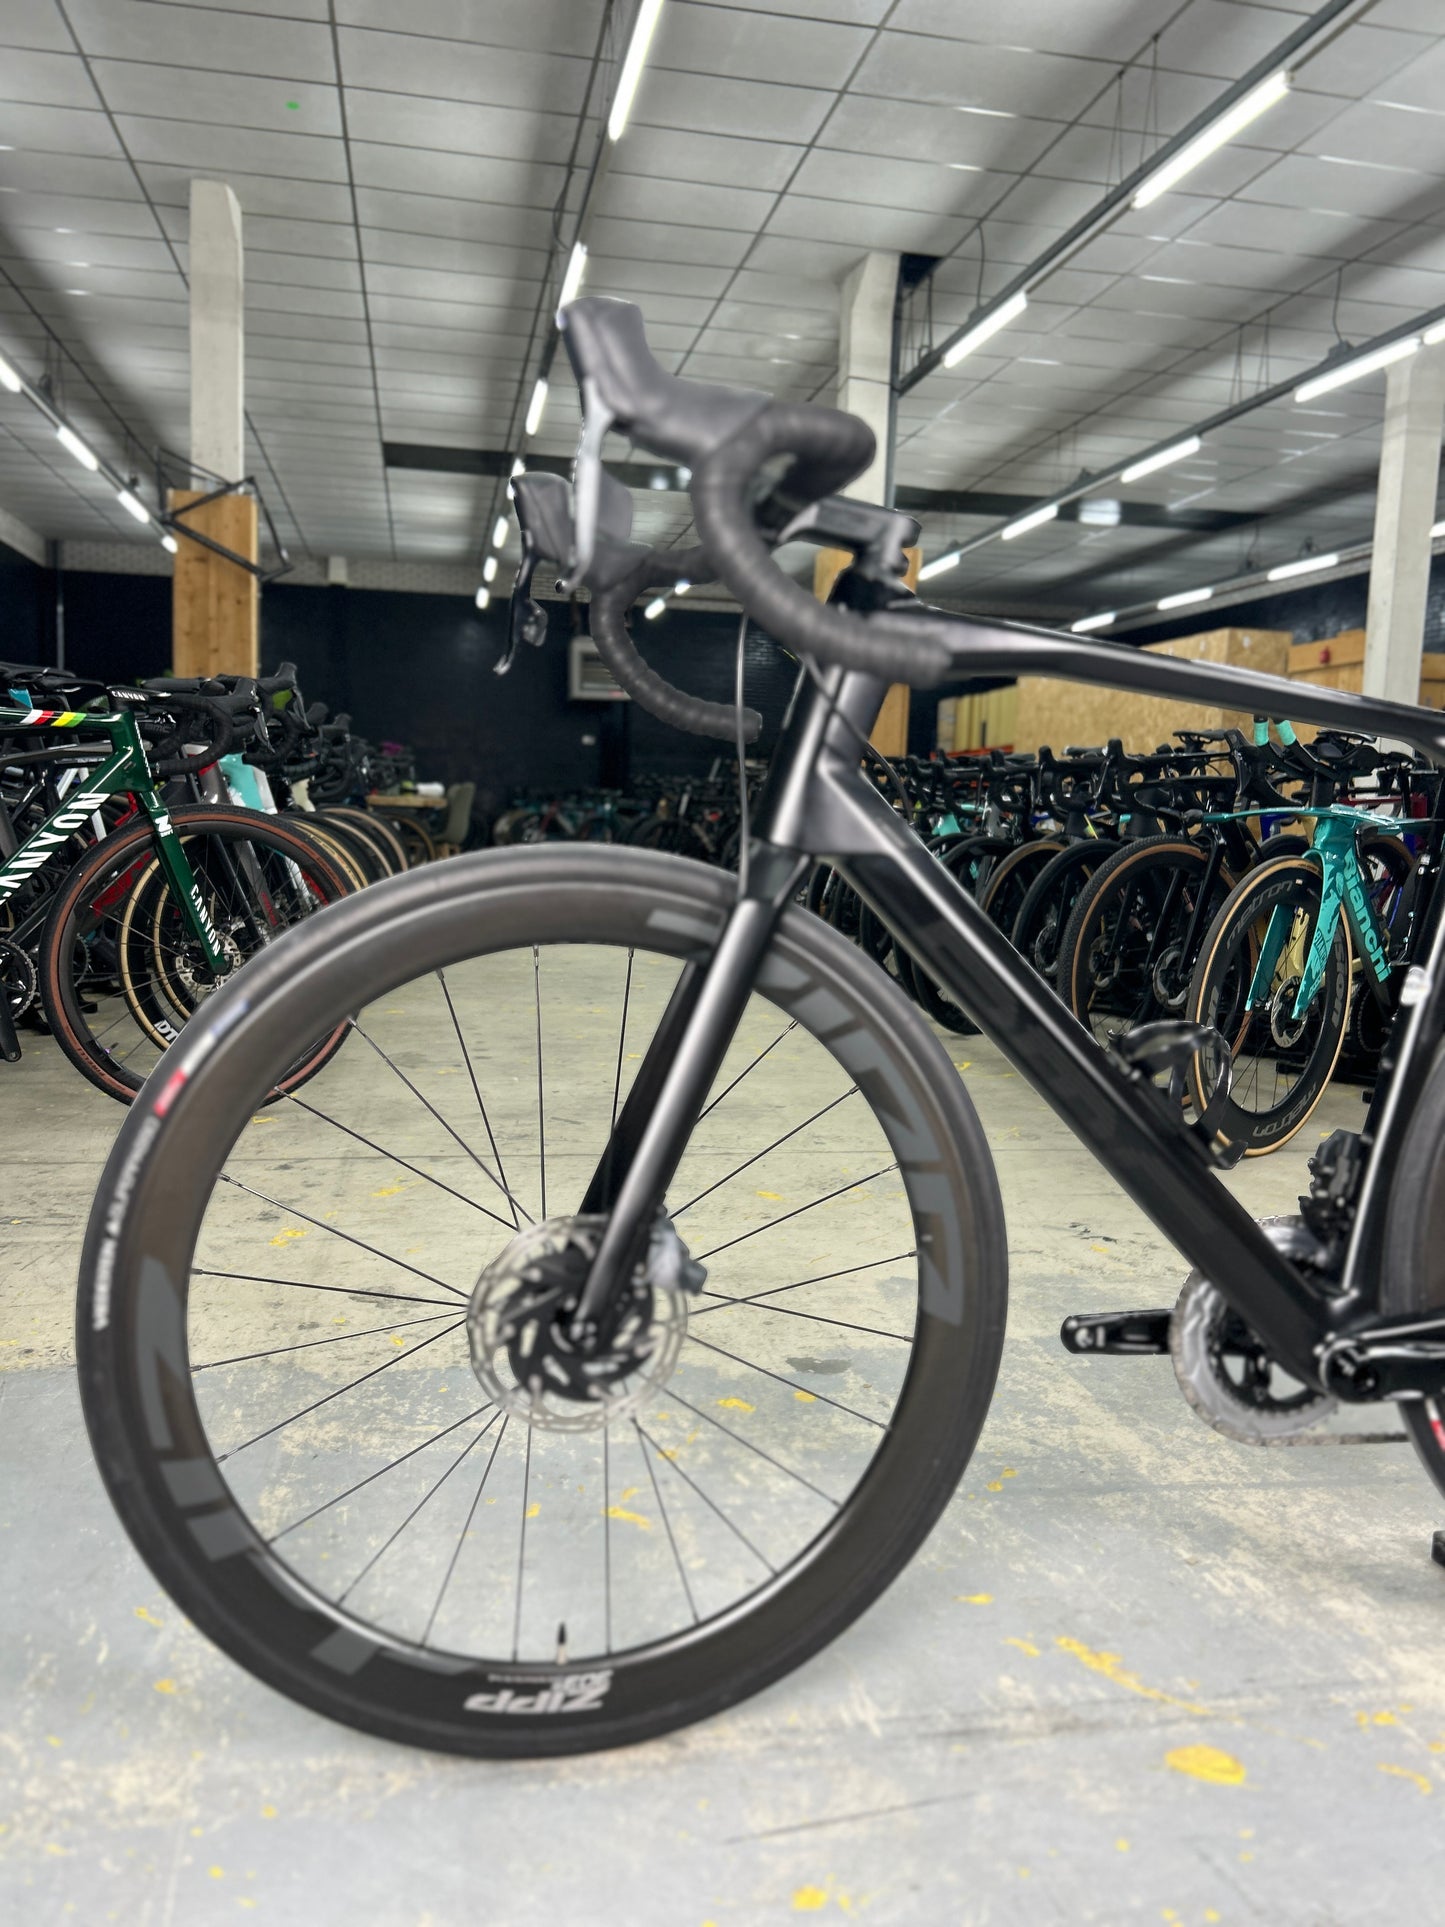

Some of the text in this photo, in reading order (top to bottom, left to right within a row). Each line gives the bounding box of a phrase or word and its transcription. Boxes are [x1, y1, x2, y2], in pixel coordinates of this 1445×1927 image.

[111, 690, 146, 701] CANYON
[0, 793, 111, 905] ANYON
[190, 884, 221, 956] CANYON
[1343, 848, 1392, 984] Bianchi
[463, 1687, 608, 1715] ZIPP
